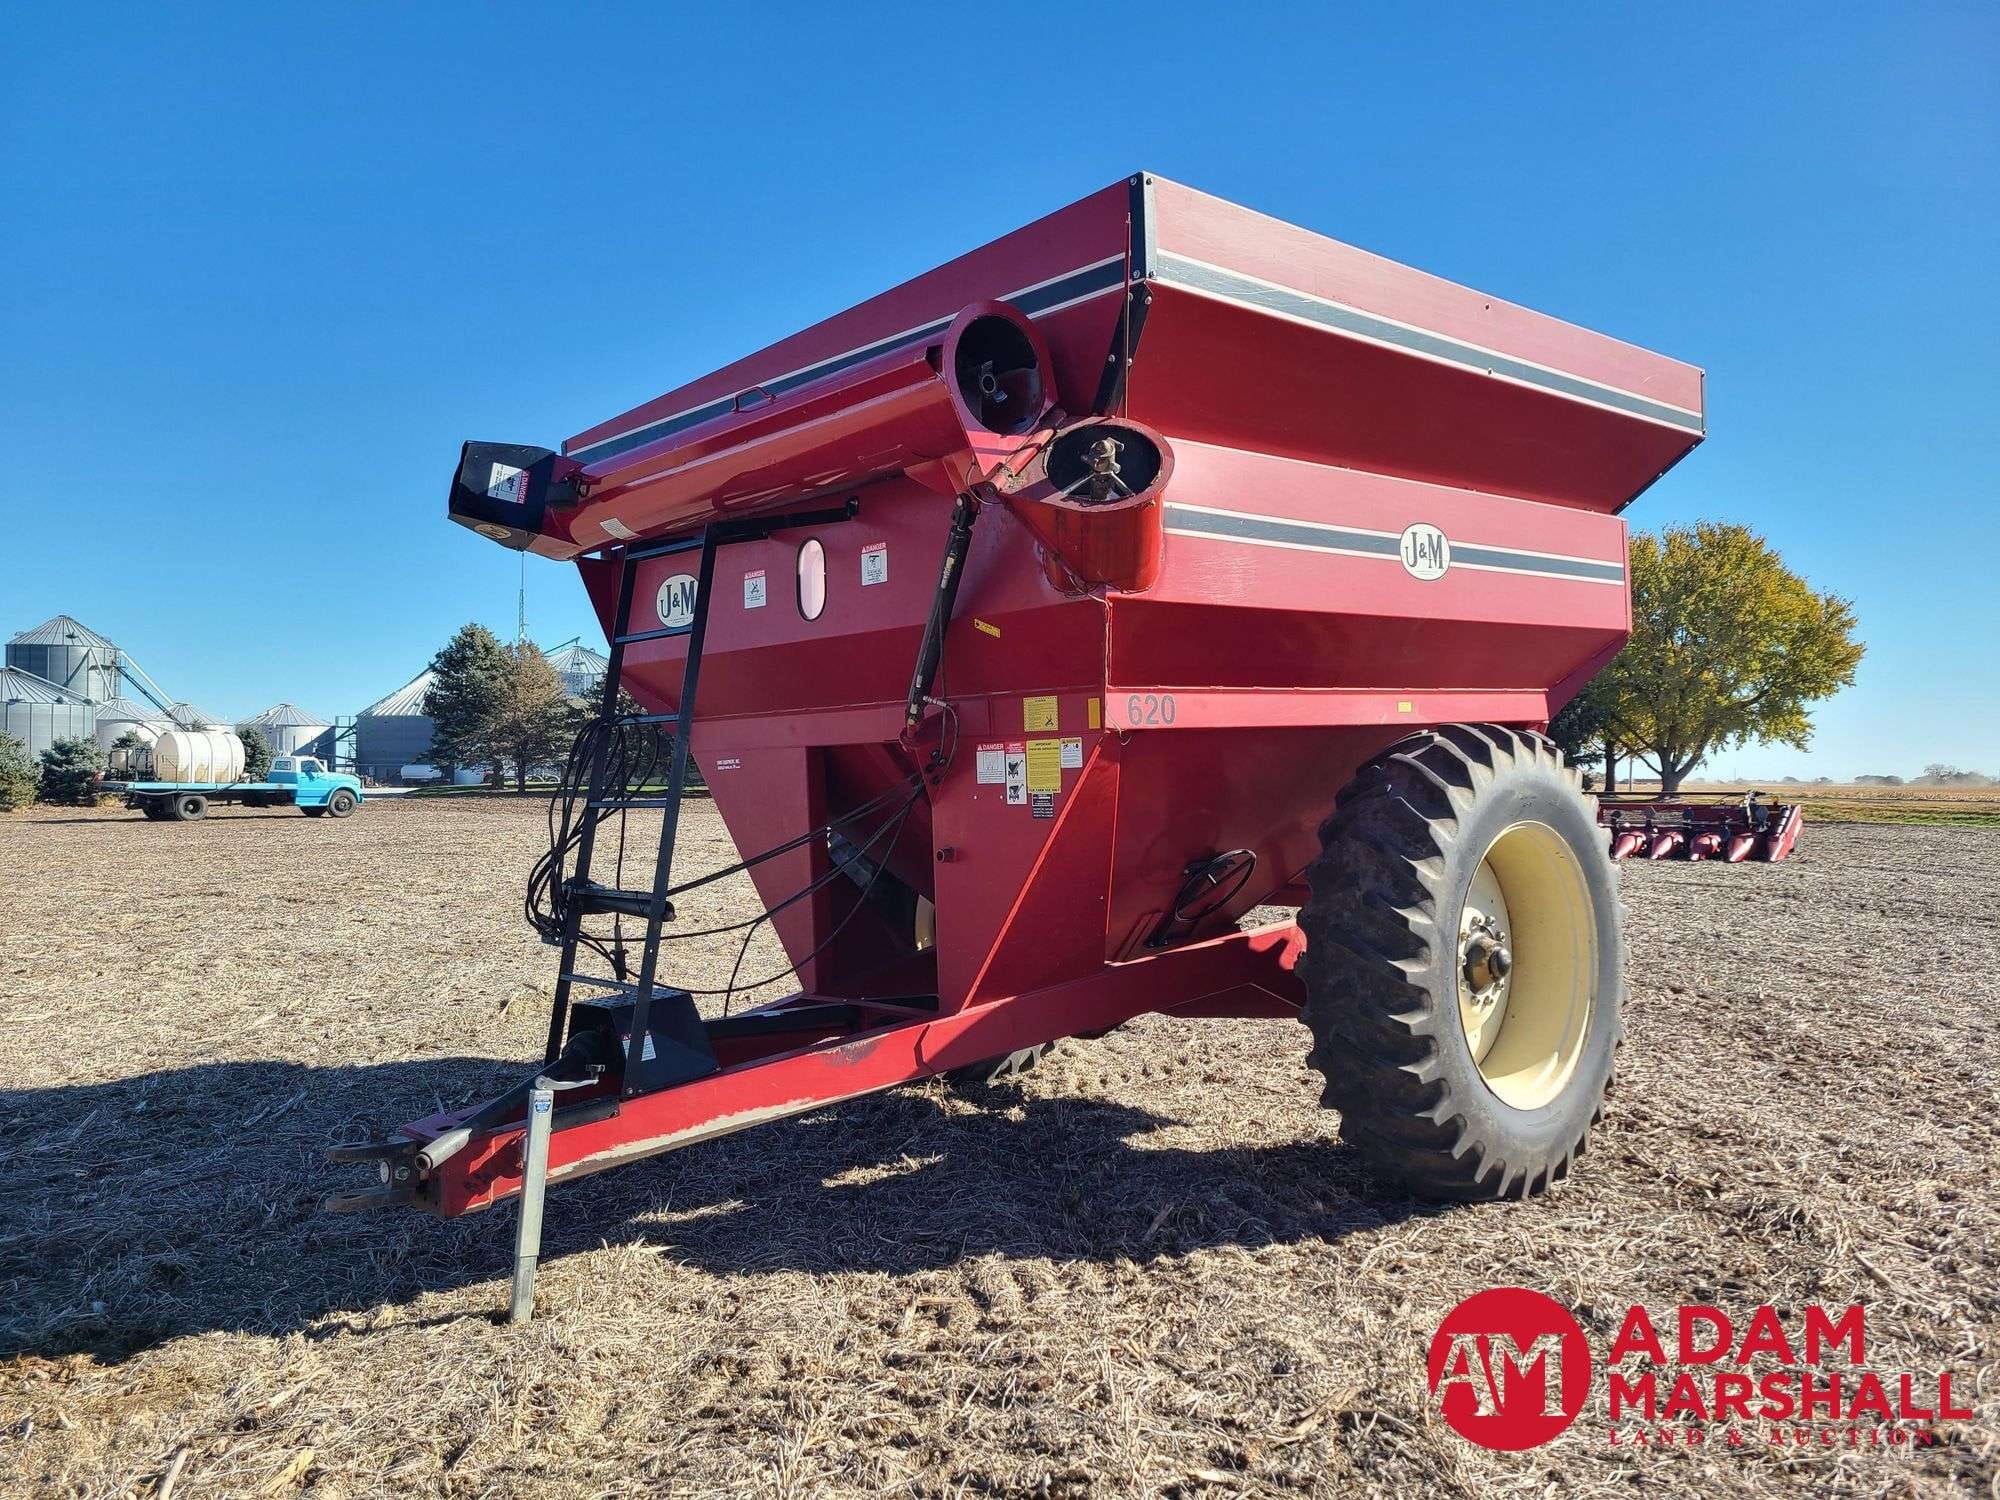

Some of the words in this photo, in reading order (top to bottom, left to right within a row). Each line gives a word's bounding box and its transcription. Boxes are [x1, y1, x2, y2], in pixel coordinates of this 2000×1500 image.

[1405, 531, 1444, 569] J&M
[660, 580, 695, 618] J&M
[1128, 694, 1176, 725] 620
